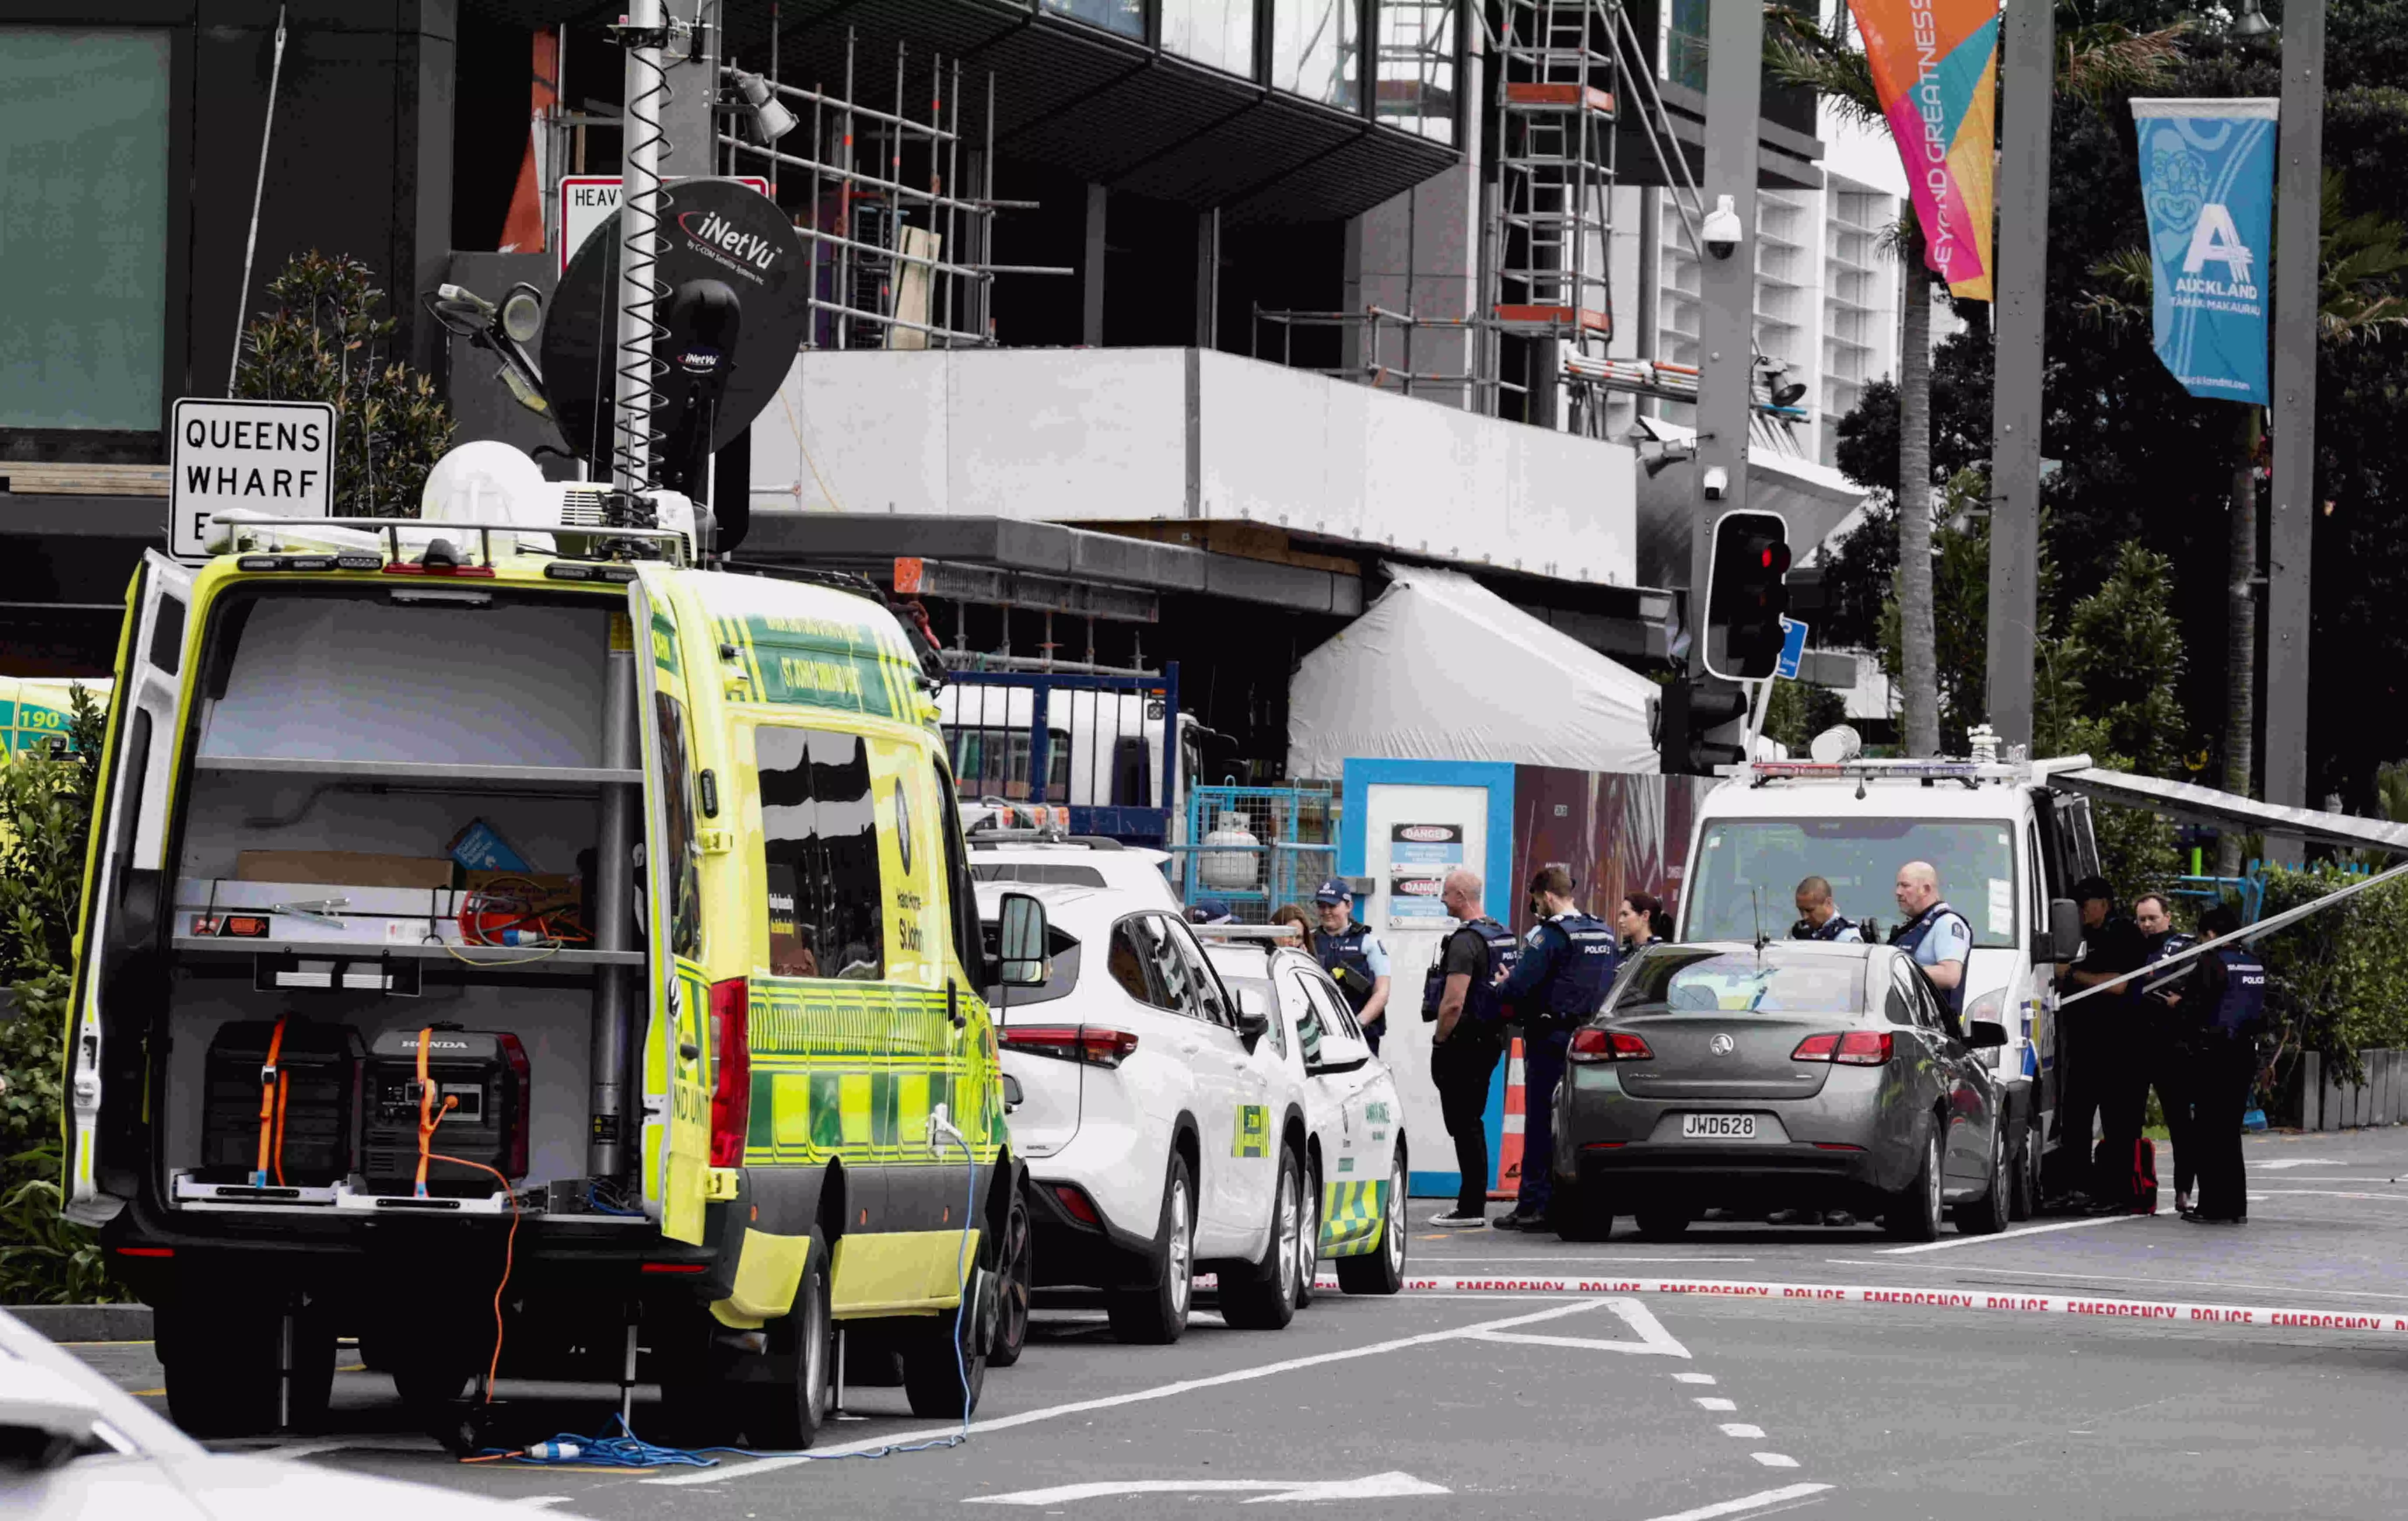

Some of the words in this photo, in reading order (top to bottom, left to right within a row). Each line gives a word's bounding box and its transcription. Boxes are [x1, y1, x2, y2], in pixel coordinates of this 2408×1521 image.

[576, 189, 622, 206] HEAV
[697, 211, 775, 269] iNetVu
[2175, 278, 2257, 299] AUCKLAND
[186, 419, 320, 452] QUEENS
[187, 466, 318, 498] WHARF
[194, 512, 211, 540] E
[21, 711, 60, 728] 190
[1406, 882, 1440, 891] DANGE
[1686, 1117, 1753, 1135] JWD628
